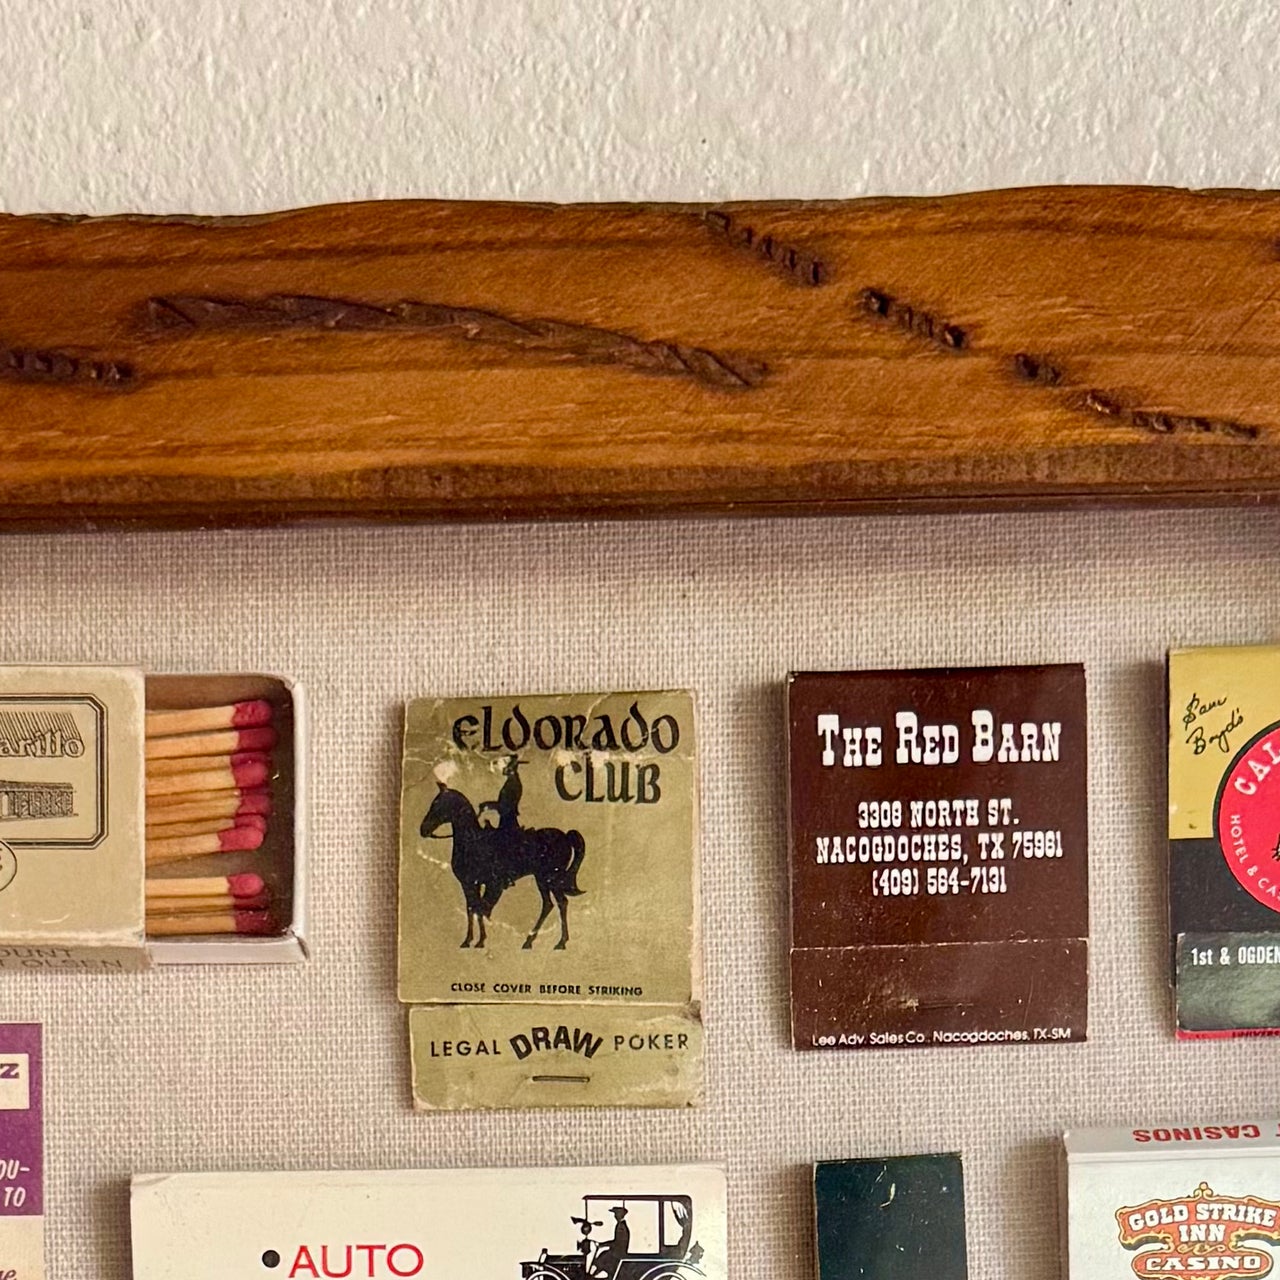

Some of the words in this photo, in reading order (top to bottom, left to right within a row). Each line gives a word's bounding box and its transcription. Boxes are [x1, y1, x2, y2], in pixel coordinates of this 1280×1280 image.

[555, 754, 660, 804] CLUB
[911, 799, 979, 828] NORTH
[988, 798, 1020, 825] ST.
[816, 833, 969, 865] NACOGDOCHES,
[978, 832, 1005, 860] TX
[1230, 815, 1248, 863] HOTEL
[873, 868, 919, 895] (409)
[927, 866, 1006, 894] 564-7131
[1191, 948, 1212, 965] 1st
[451, 983, 485, 992] CLOSE
[493, 983, 531, 993] COVER
[540, 984, 581, 994] BEFORE
[589, 985, 642, 996] STRIKING
[430, 1040, 500, 1057] LEGAL
[508, 1025, 604, 1061] DRAW
[614, 1033, 689, 1051] POKER
[812, 1034, 835, 1046] Lee
[870, 1032, 904, 1045] Sales
[1033, 1028, 1071, 1040] TX-SM
[1133, 1126, 1260, 1143] CASINOS
[4, 1187, 26, 1207] TO
[1128, 1204, 1188, 1231] GOLD
[1196, 1203, 1277, 1227] STRIKE
[1178, 1224, 1225, 1243] INN
[288, 1244, 424, 1278] AUTO
[1145, 1255, 1262, 1271] CASINO
